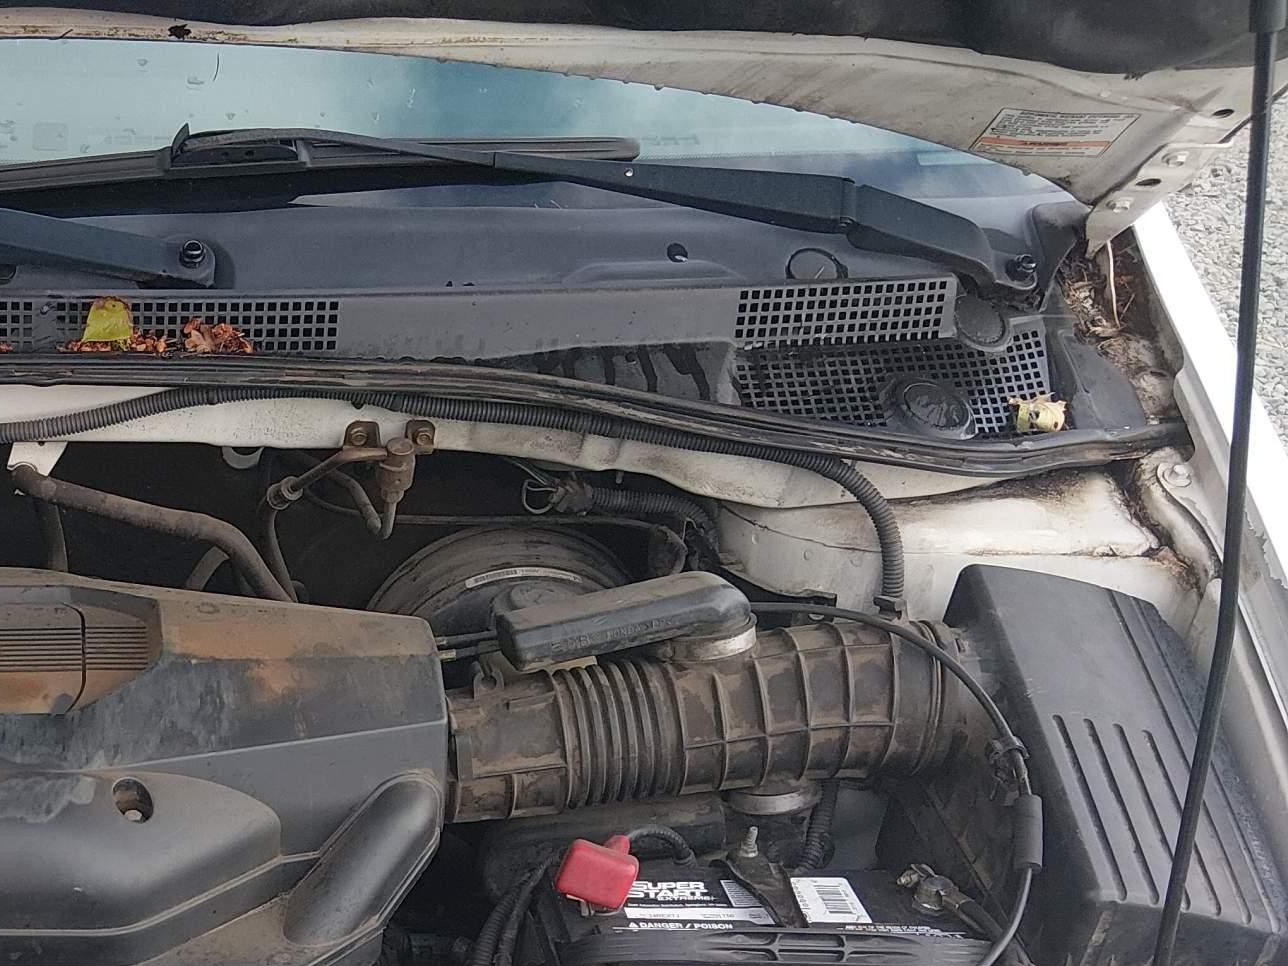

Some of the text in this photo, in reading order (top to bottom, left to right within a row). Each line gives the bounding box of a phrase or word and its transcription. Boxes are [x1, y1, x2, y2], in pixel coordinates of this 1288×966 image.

[632, 880, 705, 890] SUPER
[627, 889, 709, 899] START
[639, 922, 684, 930] DANGER
